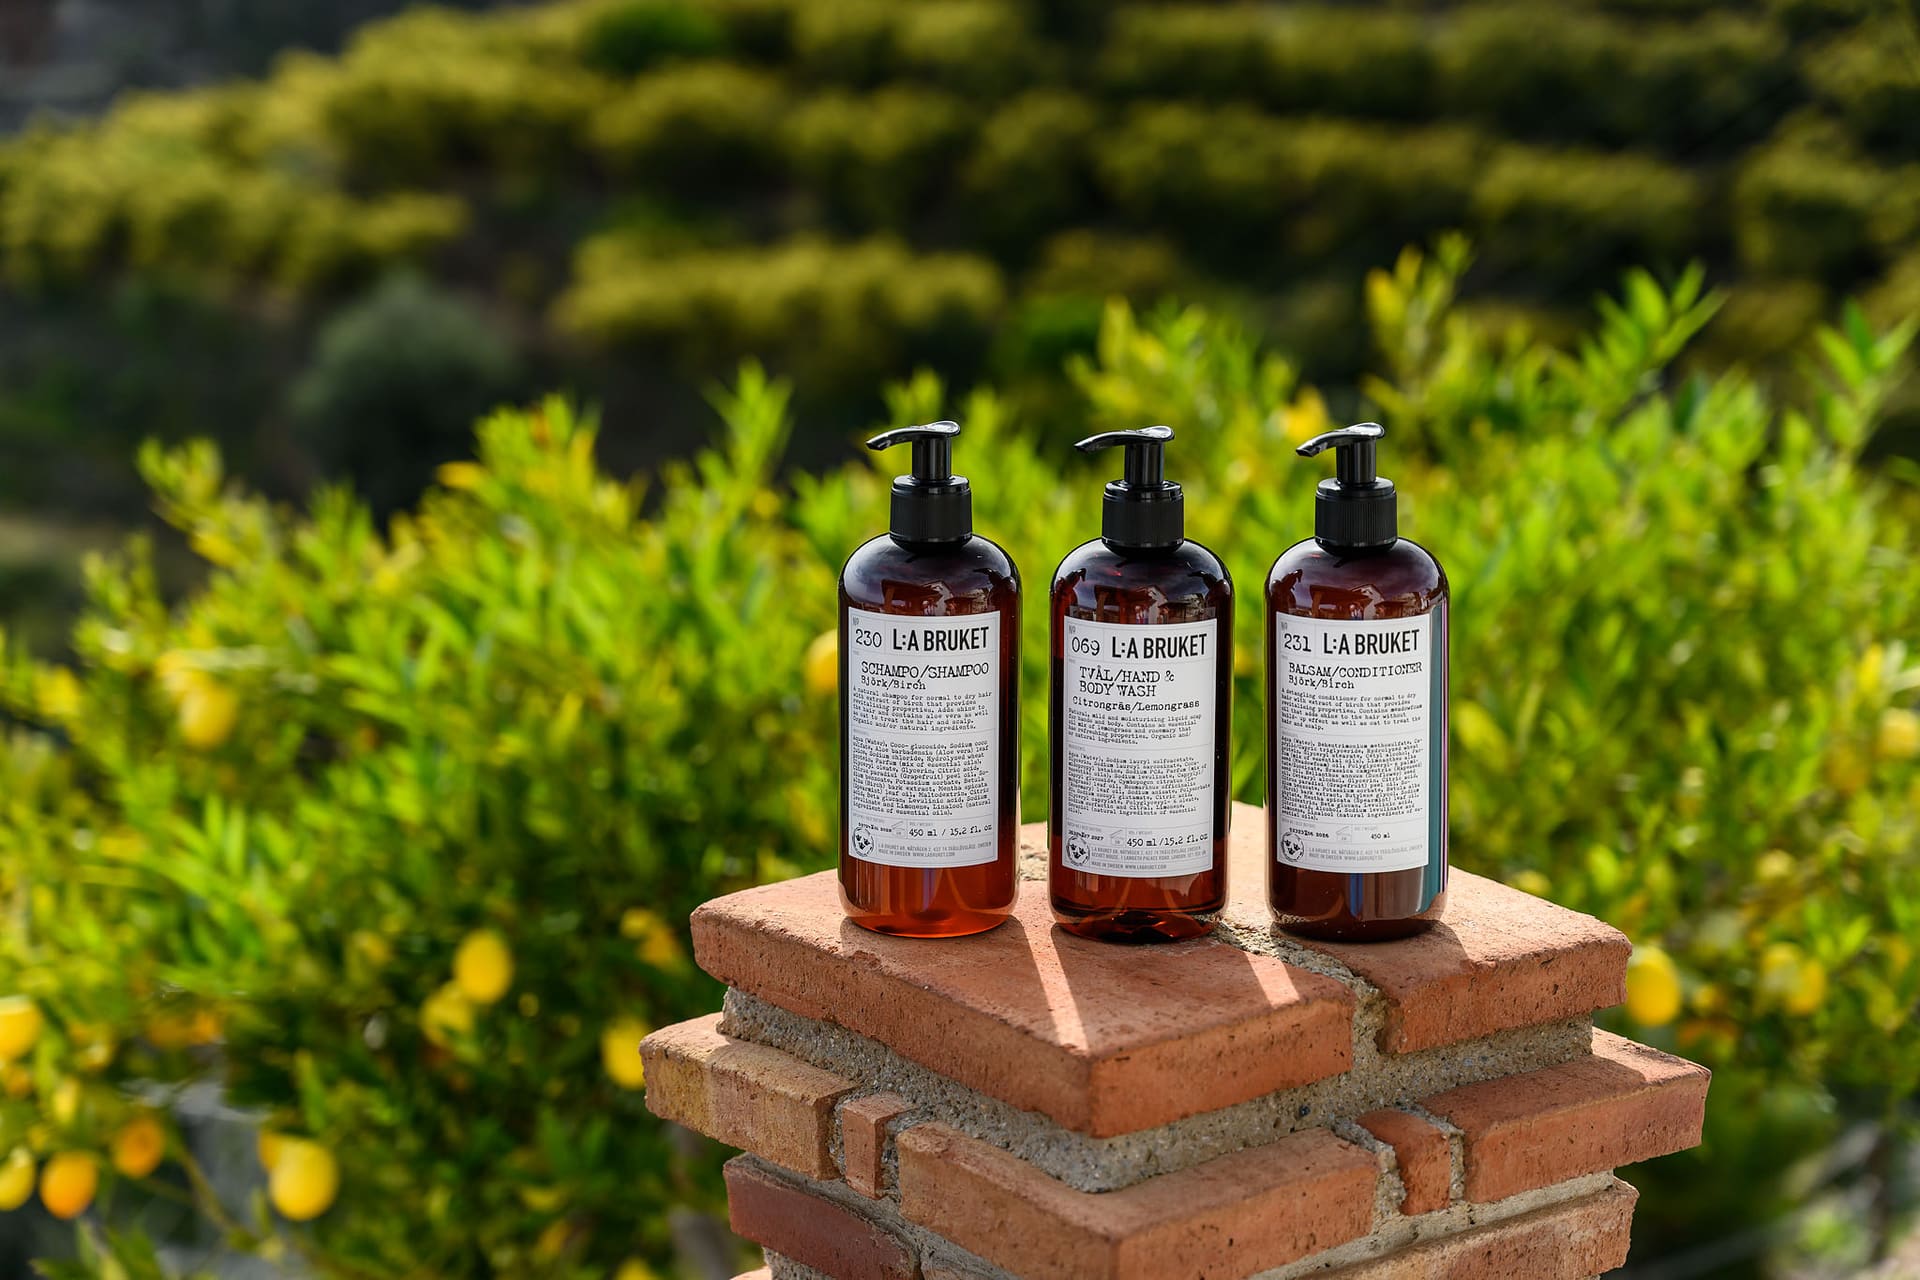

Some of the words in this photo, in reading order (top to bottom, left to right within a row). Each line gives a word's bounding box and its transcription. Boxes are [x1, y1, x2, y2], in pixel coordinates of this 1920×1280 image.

[855, 628, 882, 648] 230
[893, 628, 920, 651] L:A
[924, 626, 990, 652] BRUKET
[1072, 636, 1100, 656] 069
[1112, 636, 1138, 659] L:A
[1144, 634, 1208, 659] BRUKET
[1284, 632, 1312, 652] 231
[1323, 632, 1350, 654] L:A
[1355, 629, 1420, 654] BRUKET
[861, 660, 989, 679] SCHAMPO/SHAMPOO
[1080, 665, 1161, 683] TVÅL/HAND
[1165, 670, 1174, 682] &
[1288, 662, 1423, 678] BALSAM/CONDITIONER
[861, 674, 926, 690] Björk/Birch
[1080, 680, 1115, 696] BODY
[1117, 684, 1157, 697] WASH
[1288, 674, 1355, 690] Björk/Birch
[882, 692, 908, 701] shampoo
[1072, 696, 1200, 714] Citrongräs/Lemongrass
[908, 828, 924, 838] 450
[928, 828, 938, 836] ml
[950, 826, 968, 836] 15.2
[970, 826, 982, 834] fl.
[1127, 838, 1144, 848] 450
[1146, 838, 1158, 846] ml
